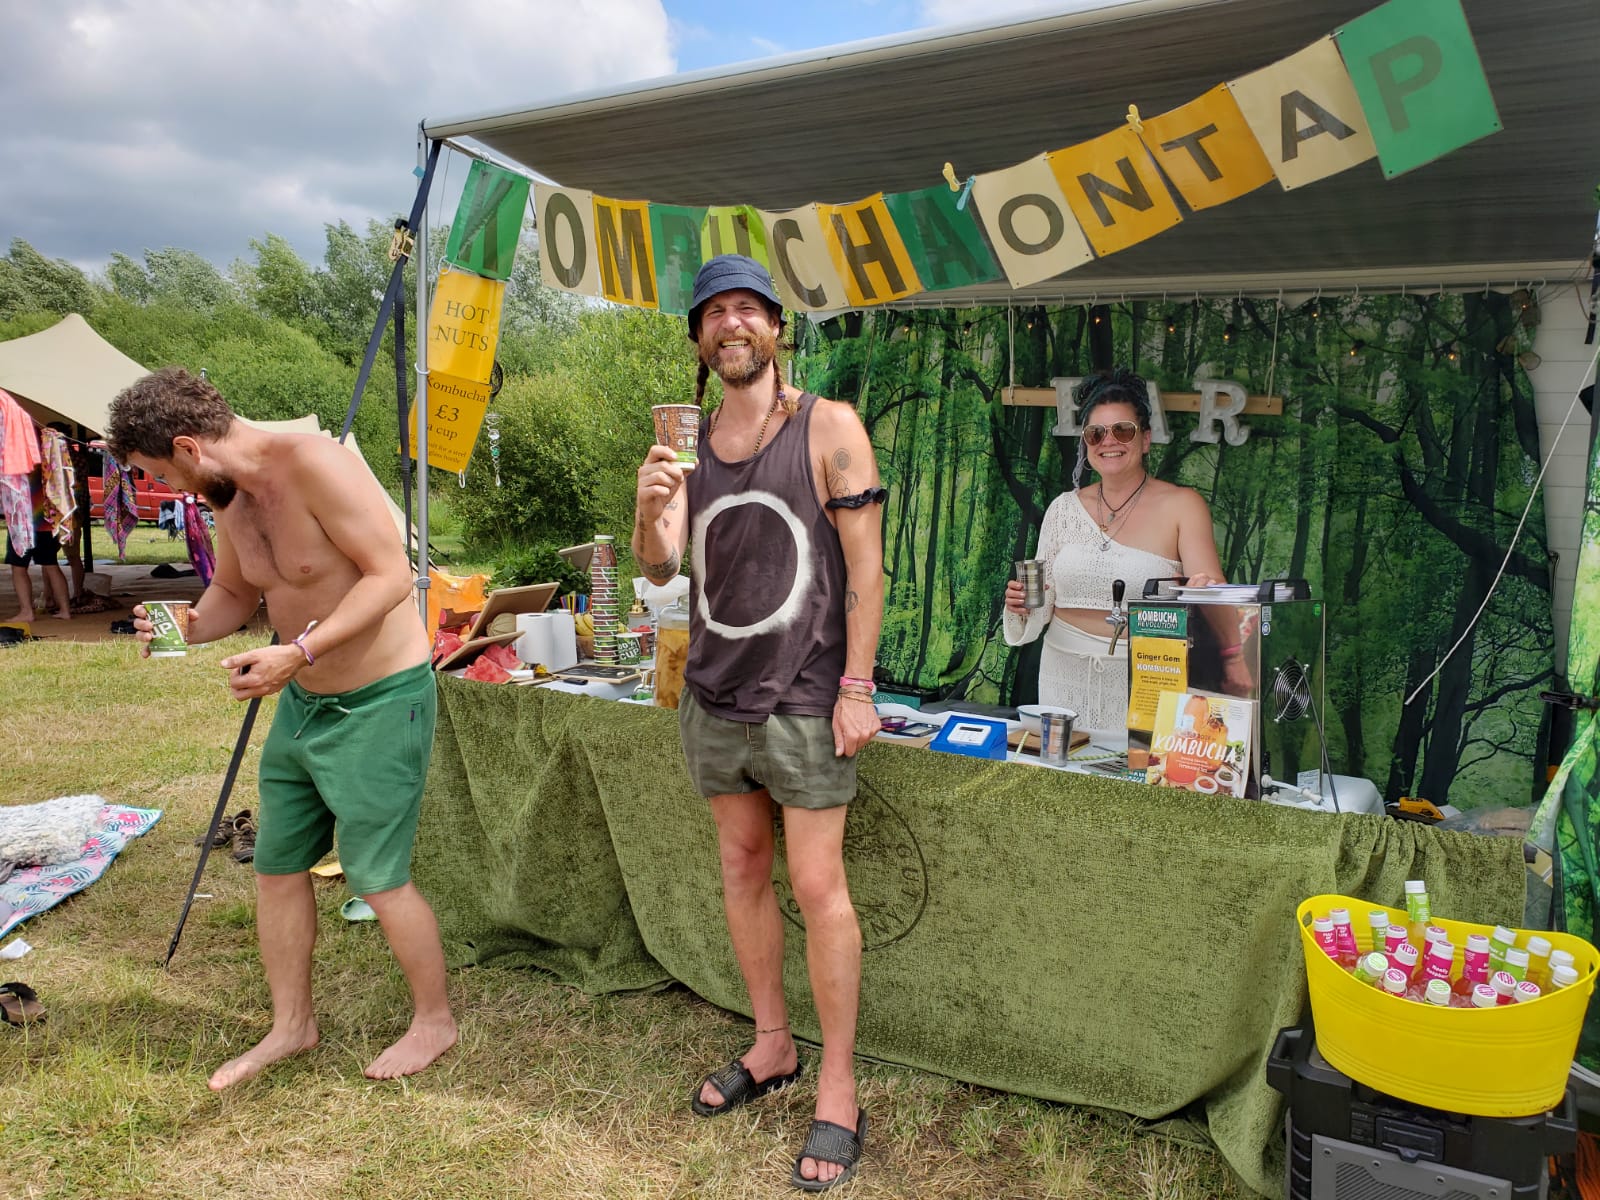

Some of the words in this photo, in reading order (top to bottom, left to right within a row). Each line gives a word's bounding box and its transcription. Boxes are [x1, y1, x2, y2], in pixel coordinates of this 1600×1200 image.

[443, 300, 490, 325] HOT
[435, 324, 489, 352] NUTS
[434, 404, 460, 422] £3
[436, 426, 458, 441] cup
[1137, 610, 1178, 623] KOMBUCHA
[1136, 652, 1161, 662] Ginger
[1136, 662, 1182, 674] KOMBUCHA
[1154, 735, 1236, 764] KOMBUCHA
